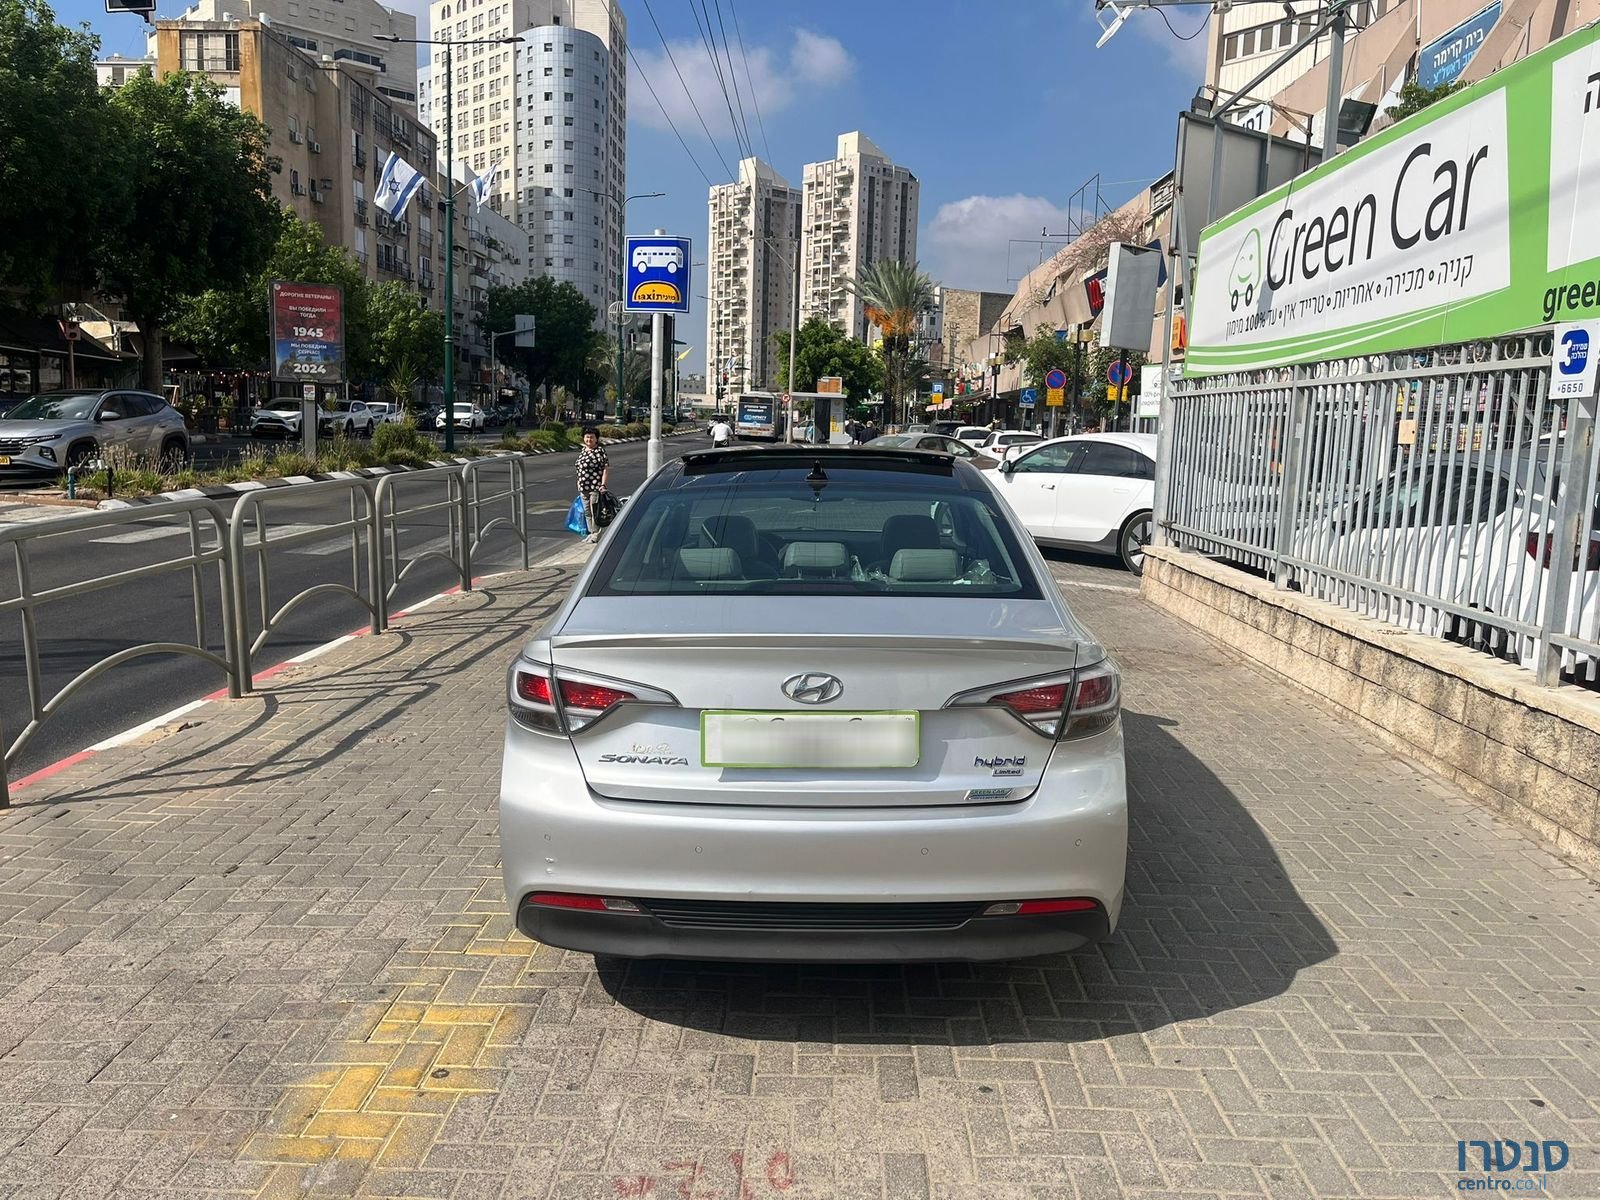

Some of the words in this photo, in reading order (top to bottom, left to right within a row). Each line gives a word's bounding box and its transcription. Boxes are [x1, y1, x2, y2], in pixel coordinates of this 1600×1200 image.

[1465, 28, 1484, 49] בית
[1266, 193, 1377, 291] Green
[1390, 142, 1489, 250] Car
[1438, 255, 1474, 288] קניה
[1384, 267, 1425, 298] מכירה
[1333, 281, 1375, 310] אחריות
[1267, 308, 1278, 326] עד
[1282, 302, 1297, 328] אין
[1299, 295, 1325, 318] טרייד
[293, 326, 324, 338] 1945
[1225, 318, 1244, 342] מימון
[1245, 311, 1266, 332] 100%
[300, 343, 327, 351] ПОБЕДИМ
[293, 363, 327, 374] 2024
[598, 754, 688, 766] SONATA
[974, 755, 1026, 768] hybrid
